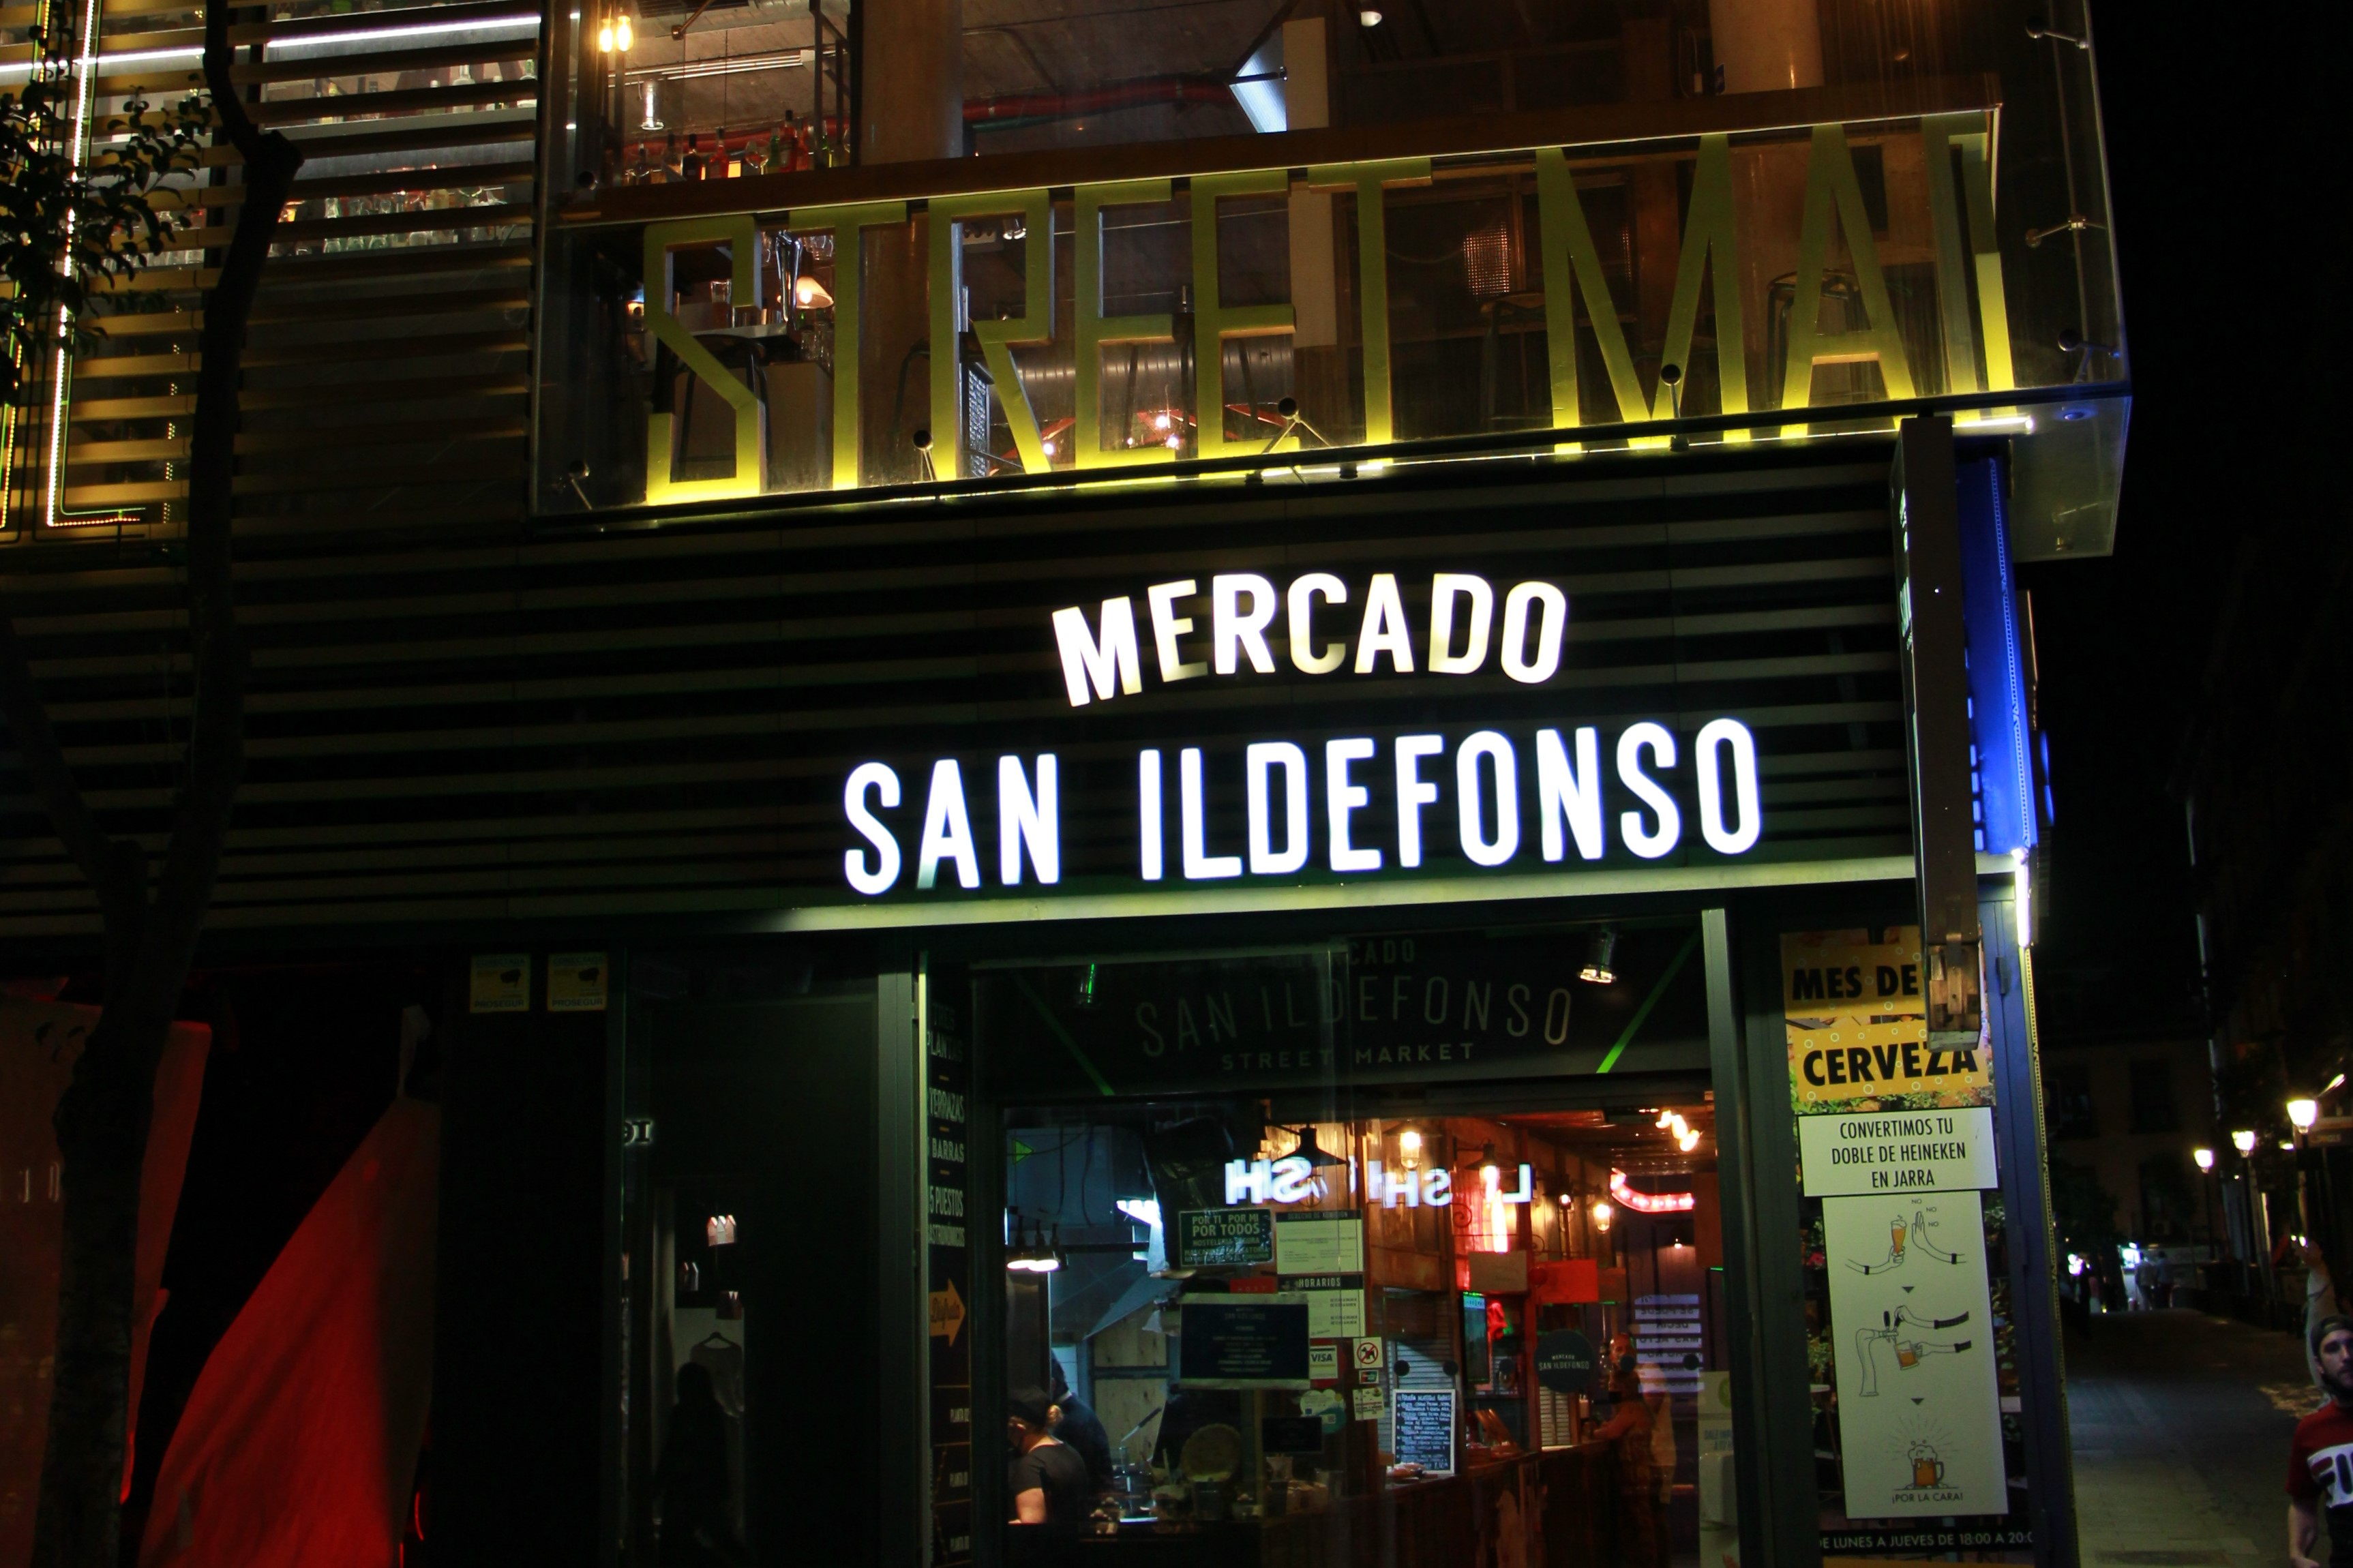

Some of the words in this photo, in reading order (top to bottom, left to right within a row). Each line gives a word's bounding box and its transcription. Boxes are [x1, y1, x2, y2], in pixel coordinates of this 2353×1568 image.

[644, 157, 1430, 508] STREET
[1052, 573, 1566, 707] MERCADO
[844, 754, 1059, 894] SAN
[1139, 717, 1763, 881] ILDEFONSO
[1349, 938, 1416, 965] CADO
[1792, 966, 1862, 1001] MES
[1876, 965, 1919, 997] DE
[474, 999, 524, 1008] PROSEGUR
[552, 997, 603, 1007] PROSEGUR
[1135, 991, 1237, 1058] SAN
[1261, 975, 1572, 1046] ILDEFONSO
[1221, 1049, 1332, 1071] STREET
[1355, 1042, 1475, 1064] MARKET
[1802, 1041, 1978, 1087] CERVEZA
[929, 1087, 965, 1124] TERRAZAS
[1840, 1118, 1933, 1139] CONVERTIMOS
[1937, 1117, 1953, 1135] TU
[932, 1138, 965, 1163] BARRAS
[1831, 1148, 1874, 1164] DOBLE
[1879, 1147, 1896, 1163] DE
[1900, 1143, 1966, 1162] HEINEKEN
[1872, 1172, 1888, 1188] EN
[1893, 1170, 1935, 1188] JARRA
[935, 1186, 964, 1218] PUESTOS
[1192, 1216, 1210, 1225] POR
[1213, 1215, 1221, 1224] TI
[1228, 1214, 1246, 1223] POR
[1192, 1225, 1216, 1237] POR
[1220, 1223, 1260, 1235] TODOS
[1298, 1277, 1341, 1287] HORARIOS
[1311, 1353, 1332, 1362] VISA
[1538, 1362, 1552, 1371] SAN
[2310, 1452, 2353, 1494] FI
[1918, 1494, 1930, 1502] LA
[1833, 1535, 1873, 1549] LUNES
[1876, 1535, 1887, 1548] A
[1888, 1534, 1935, 1548] JUEVES
[1938, 1533, 1955, 1546] DE
[1959, 1532, 1991, 1545] 18:00
[1994, 1532, 2005, 1543] A
